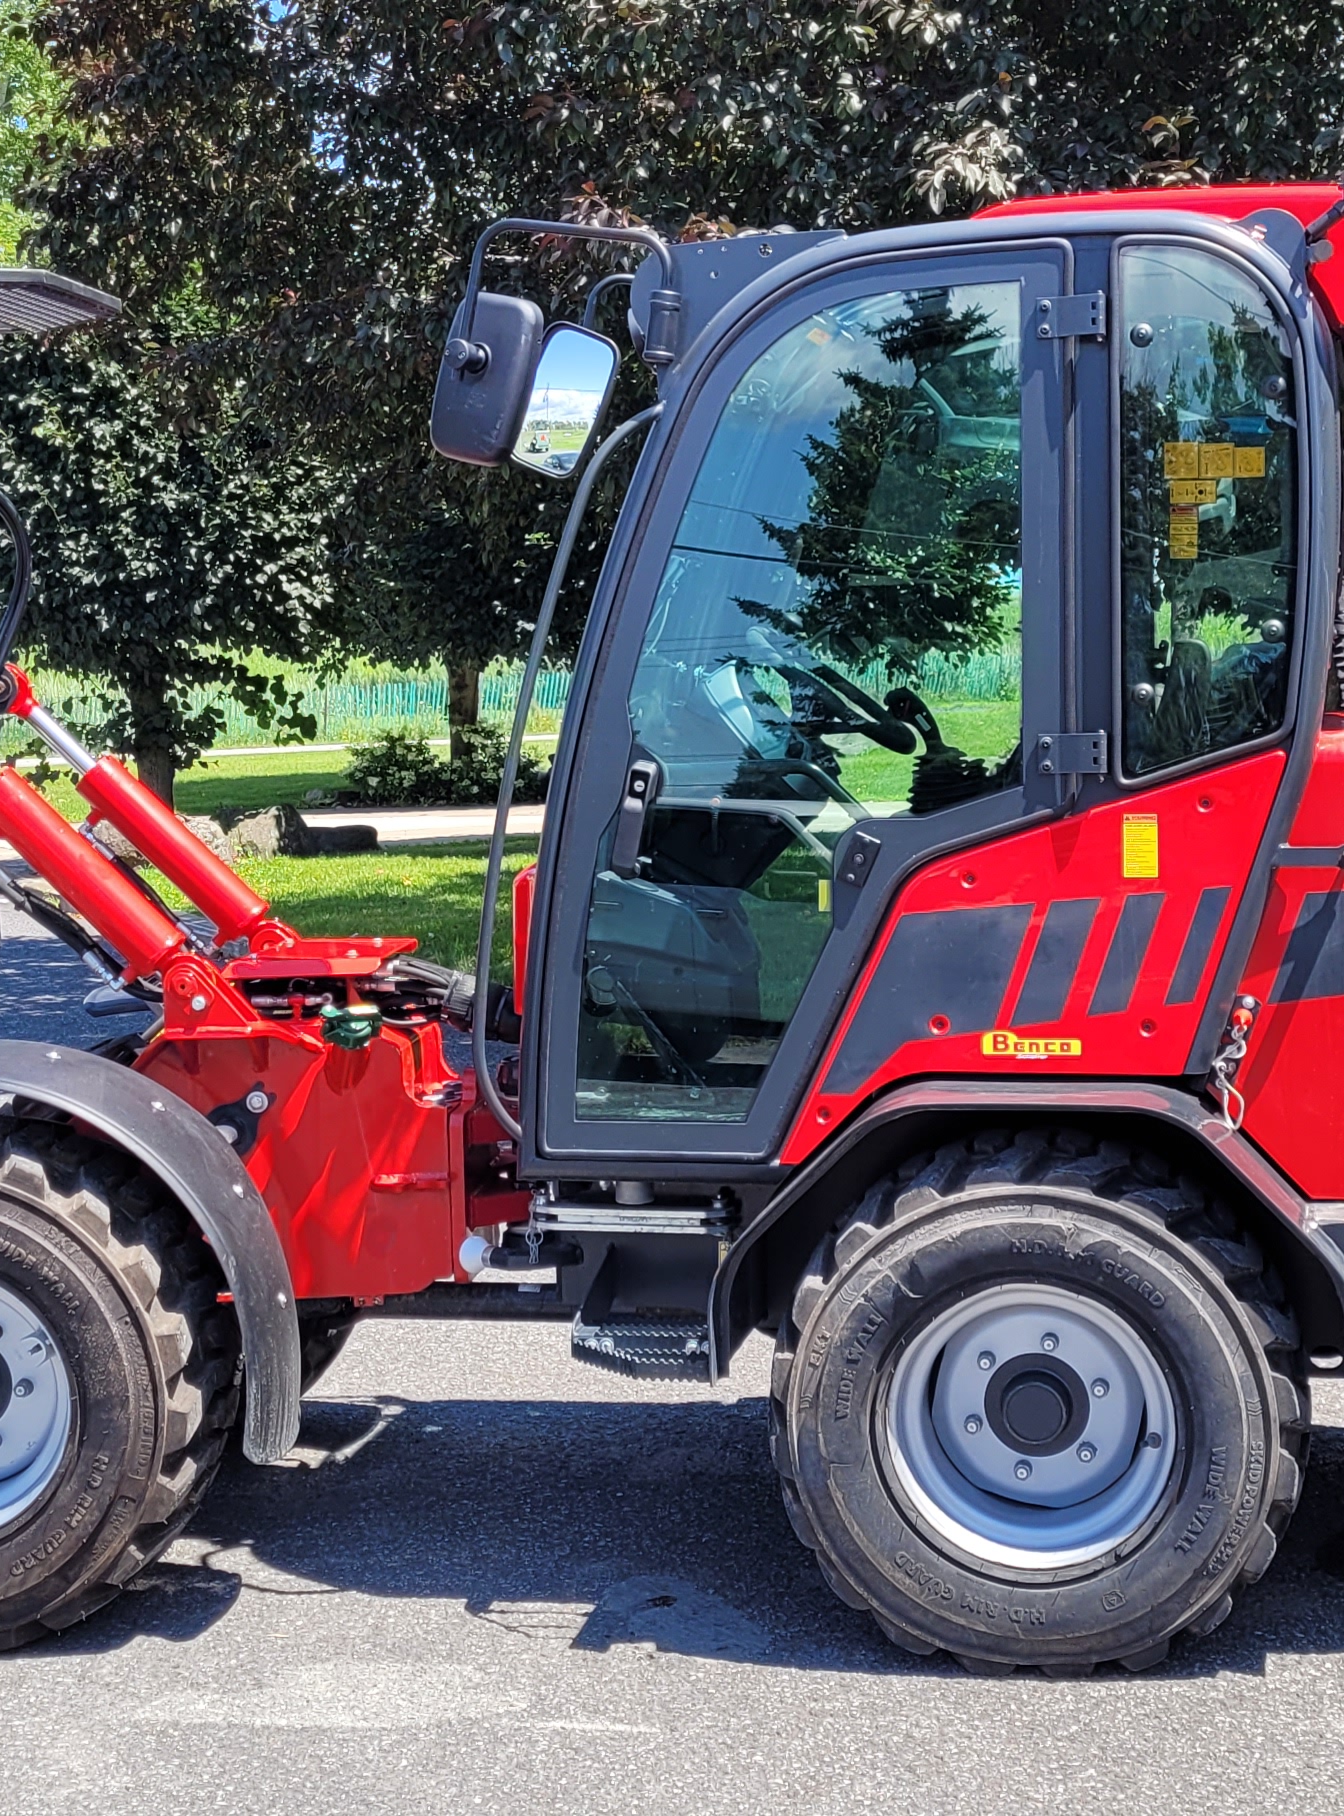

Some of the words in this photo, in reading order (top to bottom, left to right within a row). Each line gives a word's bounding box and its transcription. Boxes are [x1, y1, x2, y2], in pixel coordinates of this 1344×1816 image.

[1101, 1258, 1167, 1308] GUARD
[834, 1367, 858, 1421] WIDE
[846, 1313, 883, 1366] WALL
[1205, 1446, 1227, 1500] WIDE
[1248, 1440, 1264, 1483] SKID
[10, 1528, 67, 1576] GUARD
[1174, 1504, 1215, 1556] WALL
[894, 1551, 955, 1602] GUARD
[960, 1592, 1000, 1620] RIM
